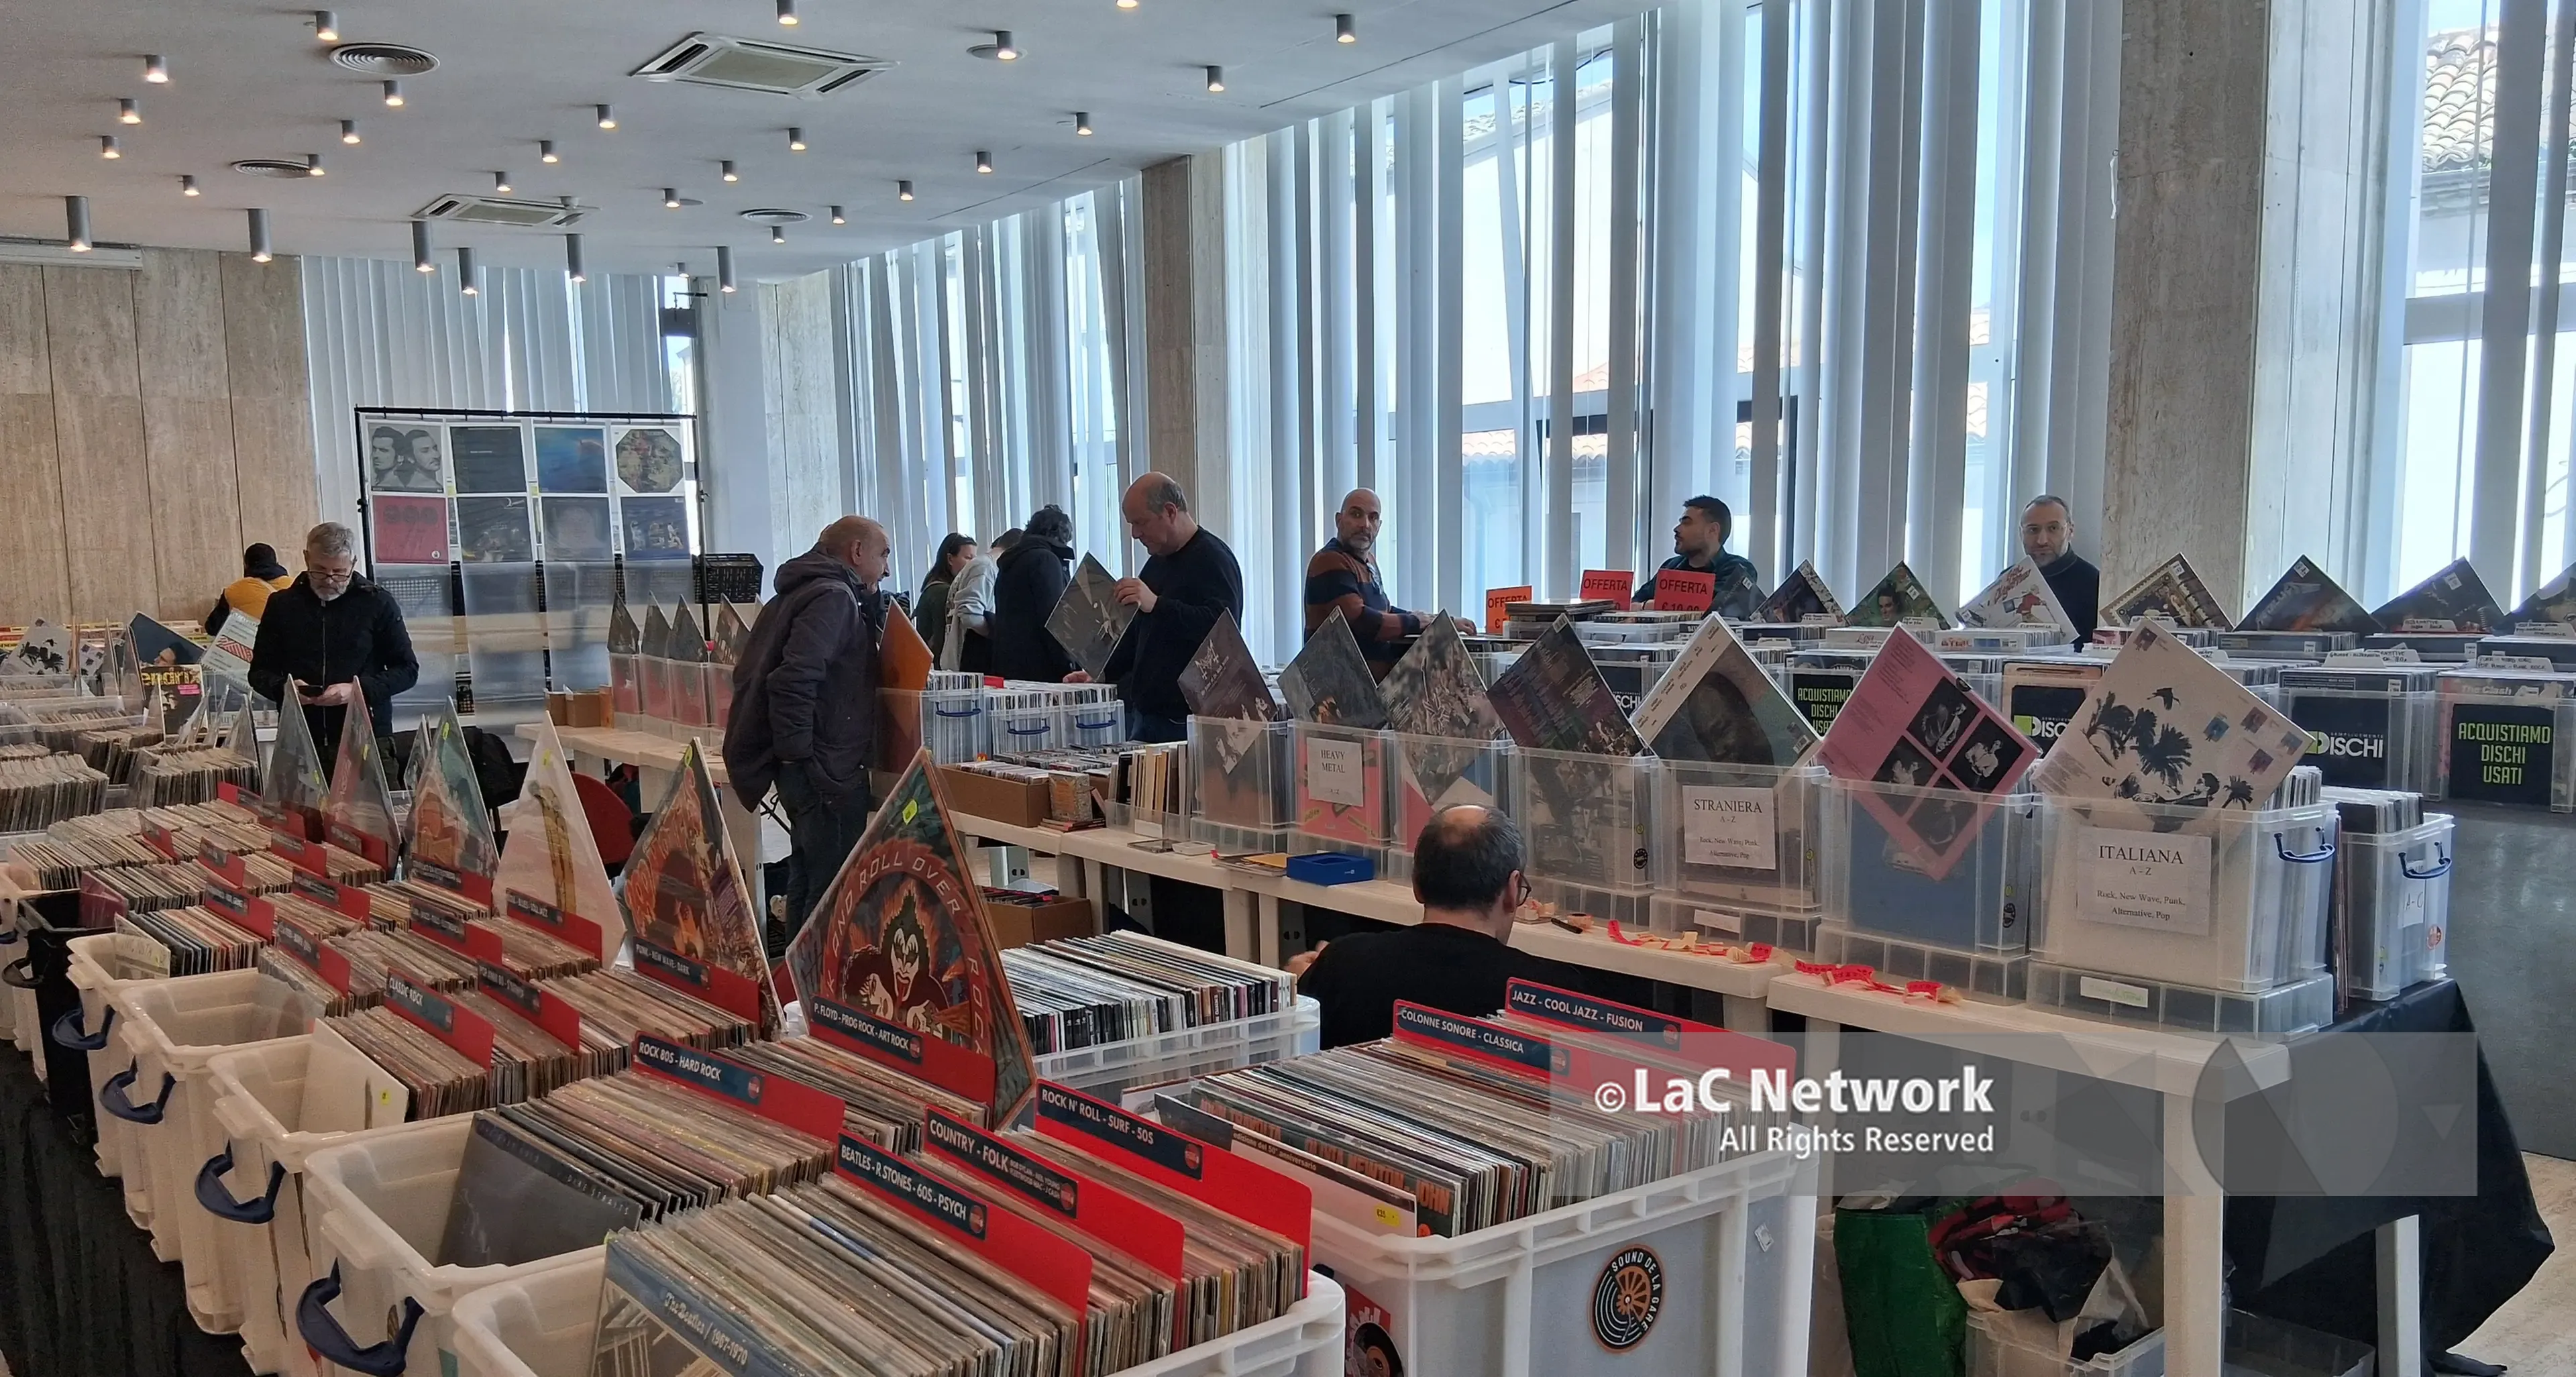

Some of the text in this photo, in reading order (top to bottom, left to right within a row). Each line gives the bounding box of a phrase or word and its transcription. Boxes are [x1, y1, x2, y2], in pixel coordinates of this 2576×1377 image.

[1583, 579, 1627, 591] OFFERTA
[1660, 578, 1707, 595] OFFERTA
[140, 668, 201, 685] endrix
[2481, 685, 2512, 695] Clash
[1813, 720, 1833, 734] USA
[2030, 716, 2068, 738] DISC
[2458, 722, 2551, 744] ACQUISTIAMO
[1321, 750, 1345, 760] HEAVY
[2312, 731, 2383, 758] DISCHI
[2481, 745, 2526, 764] DISCHI
[1322, 763, 1345, 773] METAL
[2483, 765, 2522, 785] USATI
[1694, 799, 1762, 813] STRANIERA
[2099, 845, 2184, 864] ITALIANA
[2129, 867, 2137, 875] A
[2145, 867, 2152, 875] Z
[859, 850, 961, 916] ROLL OVER
[2097, 890, 2117, 899] Rock,
[2119, 891, 2137, 900] New
[2139, 894, 2162, 904] Wave,
[2112, 907, 2171, 921] Alternative, Pop
[389, 977, 424, 1007] CLASSIC ROCK
[1512, 990, 1536, 1005] JAZZ
[1544, 998, 1571, 1015] COOL
[1573, 1004, 1598, 1021] JAZZ
[1606, 1013, 1644, 1032] FUSION
[814, 1003, 820, 1013] P.
[820, 1005, 838, 1020] FLOYD
[841, 1013, 857, 1030] PROG
[858, 1020, 875, 1037] ROCK
[878, 1029, 891, 1043] ART
[891, 1035, 910, 1050] ROCK
[1401, 1008, 1440, 1028] COLONNE
[1442, 1018, 1477, 1039] SONORE
[1483, 1032, 1524, 1054] CLASSICA
[639, 1042, 659, 1059] ROCK
[660, 1049, 674, 1064] 80S
[679, 1056, 700, 1072] HARD
[700, 1063, 722, 1081] ROCK
[1042, 1089, 1067, 1109] ROCK
[1068, 1098, 1078, 1112] N'
[1079, 1103, 1101, 1122] ROLL
[1108, 1114, 1130, 1134] SURF
[1137, 1126, 1154, 1145] 50S
[930, 1119, 975, 1154] COUNTRY
[983, 1145, 1009, 1172] FOLK
[1233, 1132, 1257, 1146] edizione
[1258, 1141, 1267, 1150] del
[1279, 1150, 1317, 1170] anniversario
[841, 1144, 871, 1170] BEATLES
[876, 1162, 881, 1176] R
[883, 1165, 912, 1192] STONES
[917, 1183, 933, 1203] 60S
[938, 1193, 967, 1220] PSYCH
[568, 1175, 629, 1215] DIRE STRAITS
[1611, 1251, 1661, 1331] SOUND DE LA GARE
[678, 1302, 705, 1334] Beatles
[711, 1328, 748, 1366] 1967-1970
